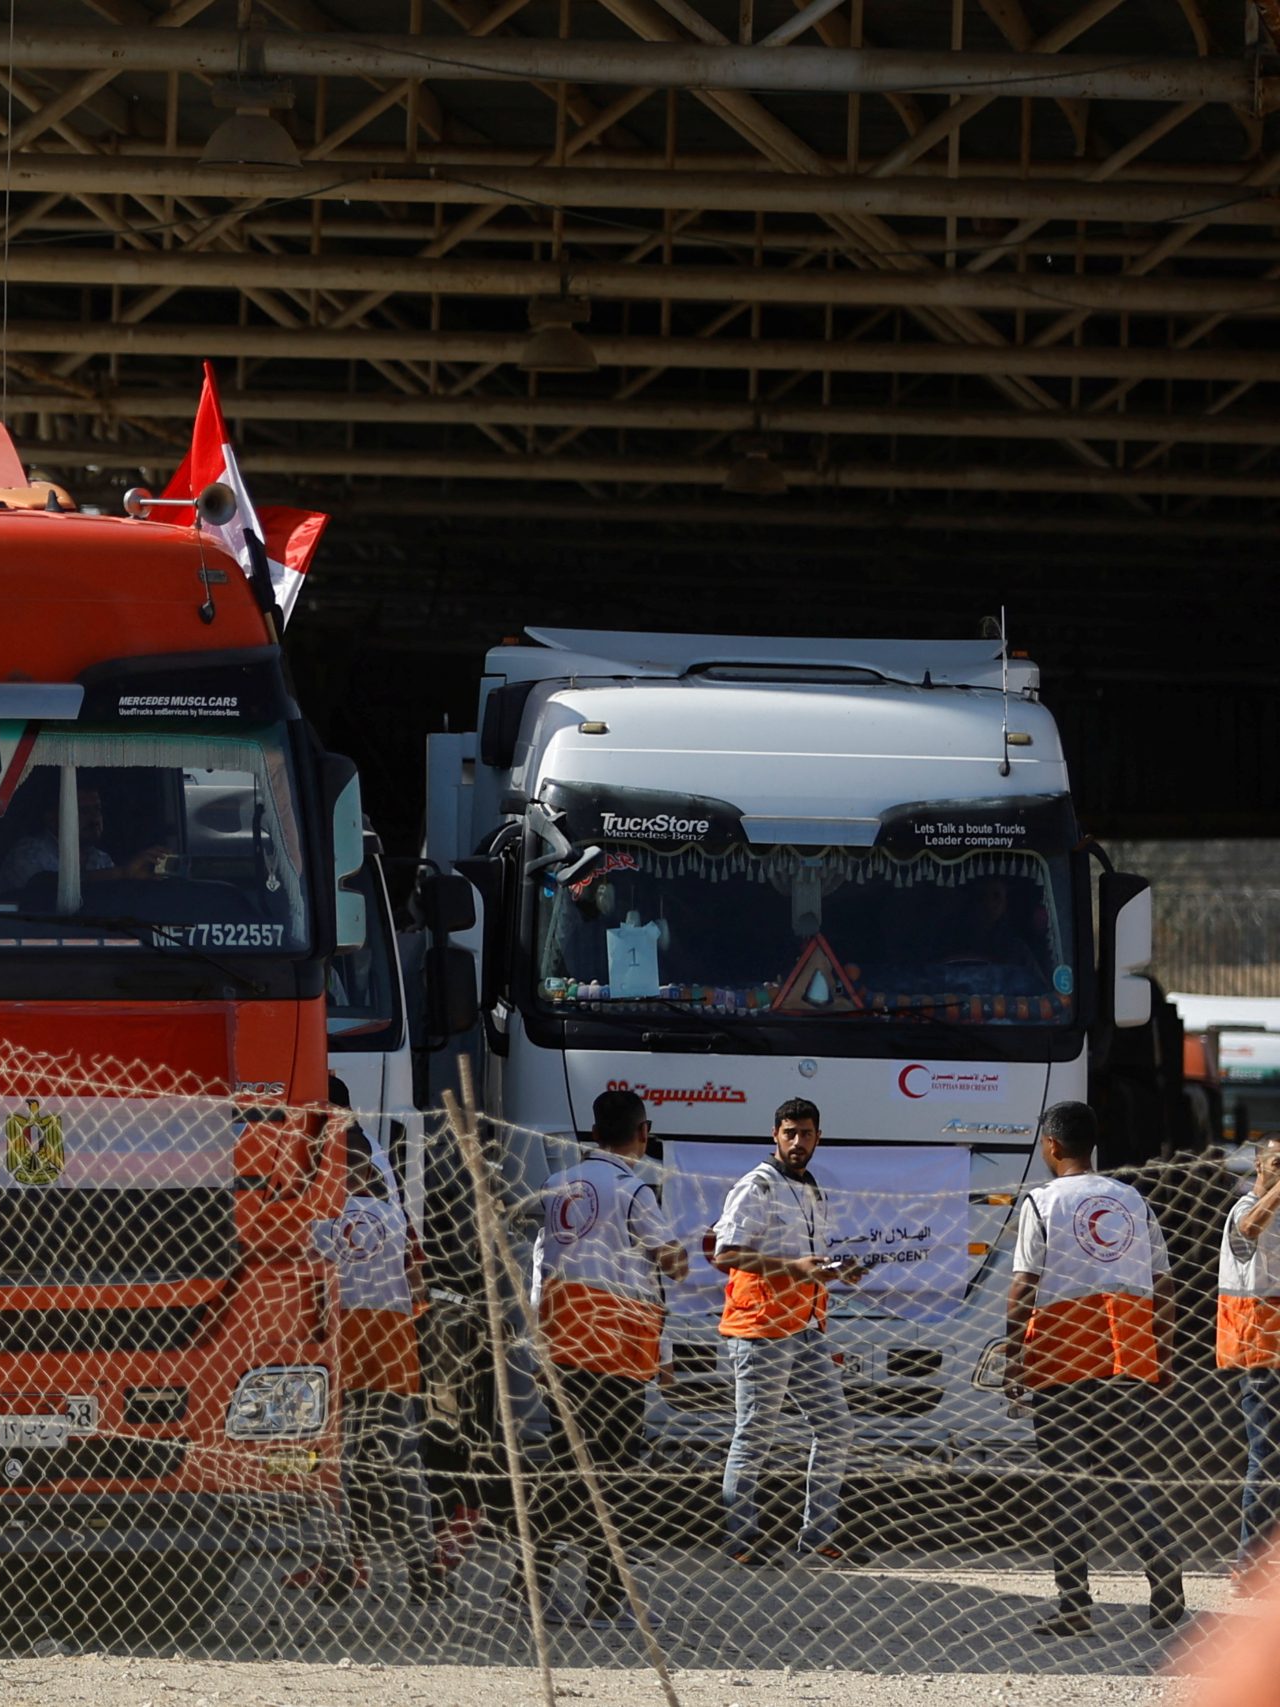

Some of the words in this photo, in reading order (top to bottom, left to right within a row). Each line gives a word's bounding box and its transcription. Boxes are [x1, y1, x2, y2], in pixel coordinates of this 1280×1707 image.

[119, 697, 170, 706] MERCEDES
[171, 697, 207, 706] MUSCL
[208, 697, 238, 707] CARS
[600, 813, 709, 833] TruckStore
[915, 823, 935, 834] Lets
[937, 823, 956, 834] Talk
[958, 826, 964, 834] a
[966, 823, 993, 834] boute
[994, 823, 1026, 834] Trucks
[604, 829, 705, 841] Mercedes-Benz
[925, 835, 961, 846] Leader
[964, 837, 1013, 848] company
[627, 947, 640, 967] 1
[863, 1249, 930, 1264] CRESCENT
